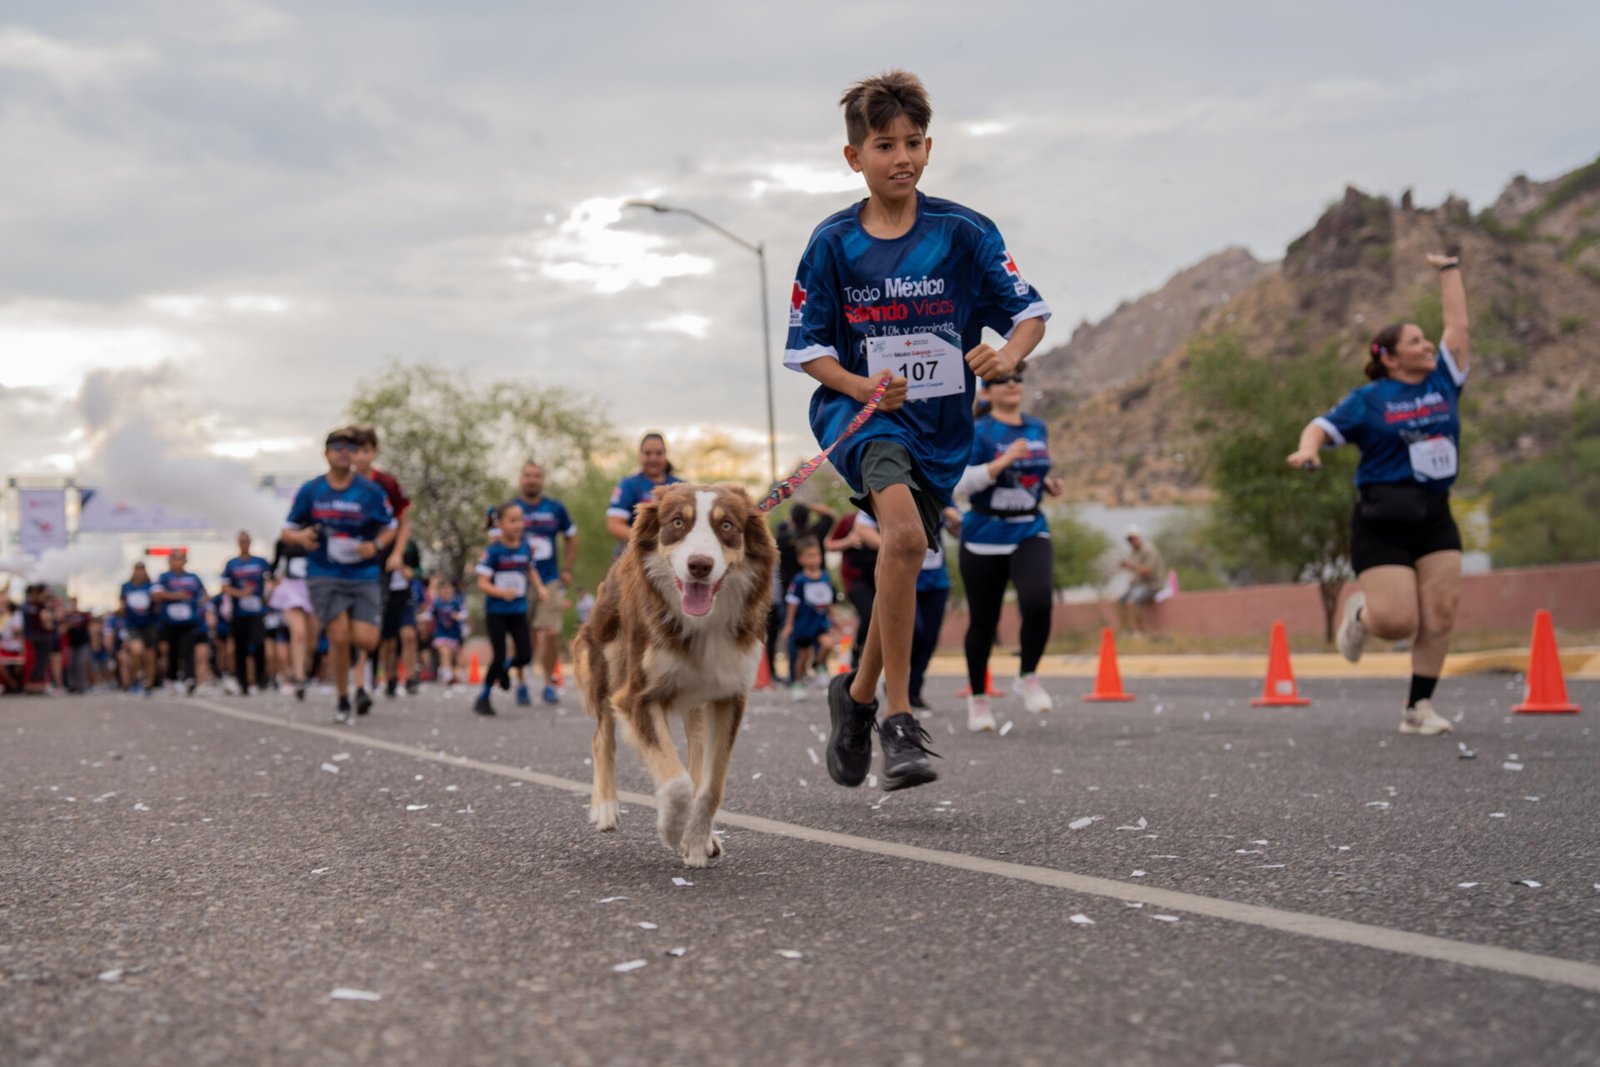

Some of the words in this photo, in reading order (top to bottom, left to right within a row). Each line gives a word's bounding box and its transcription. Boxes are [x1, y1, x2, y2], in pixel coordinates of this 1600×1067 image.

[844, 285, 881, 303] Todo
[885, 276, 945, 298] México
[912, 300, 954, 316] Vidas
[899, 361, 939, 381] 107
